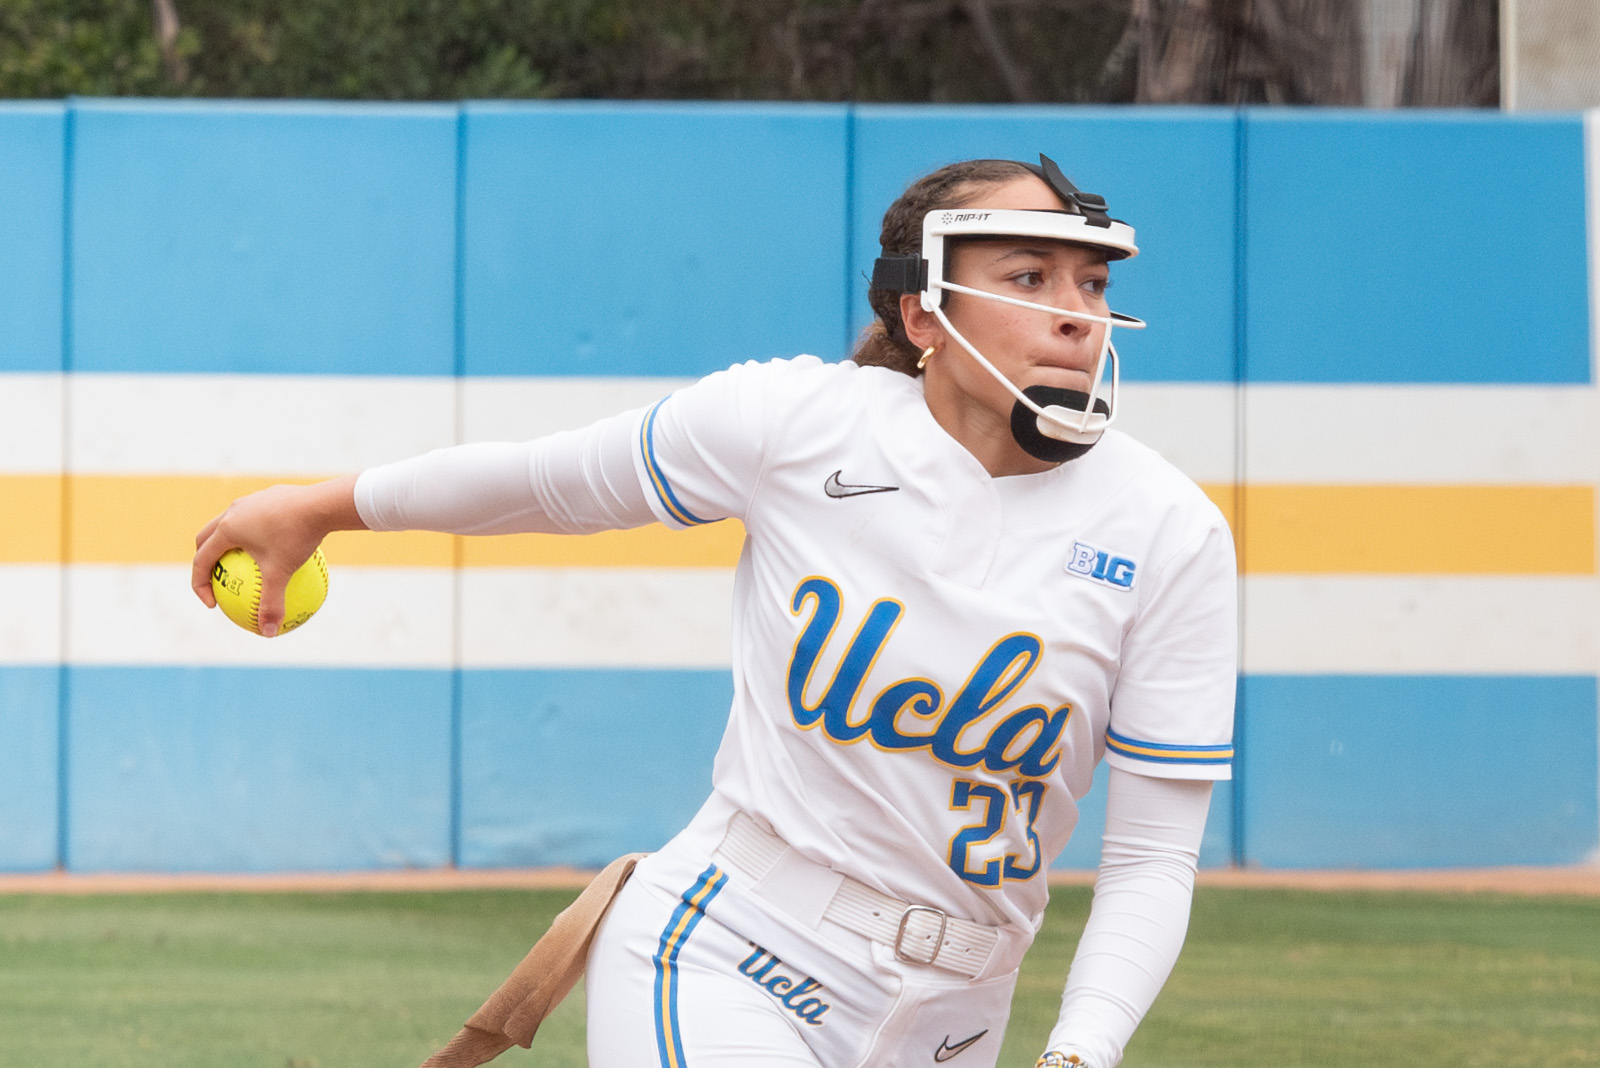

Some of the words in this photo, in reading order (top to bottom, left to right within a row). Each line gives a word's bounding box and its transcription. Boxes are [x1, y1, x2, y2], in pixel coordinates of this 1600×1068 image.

[785, 574, 1074, 780] Ucla
[946, 777, 1050, 890] 23
[737, 941, 831, 1026] Ucla
